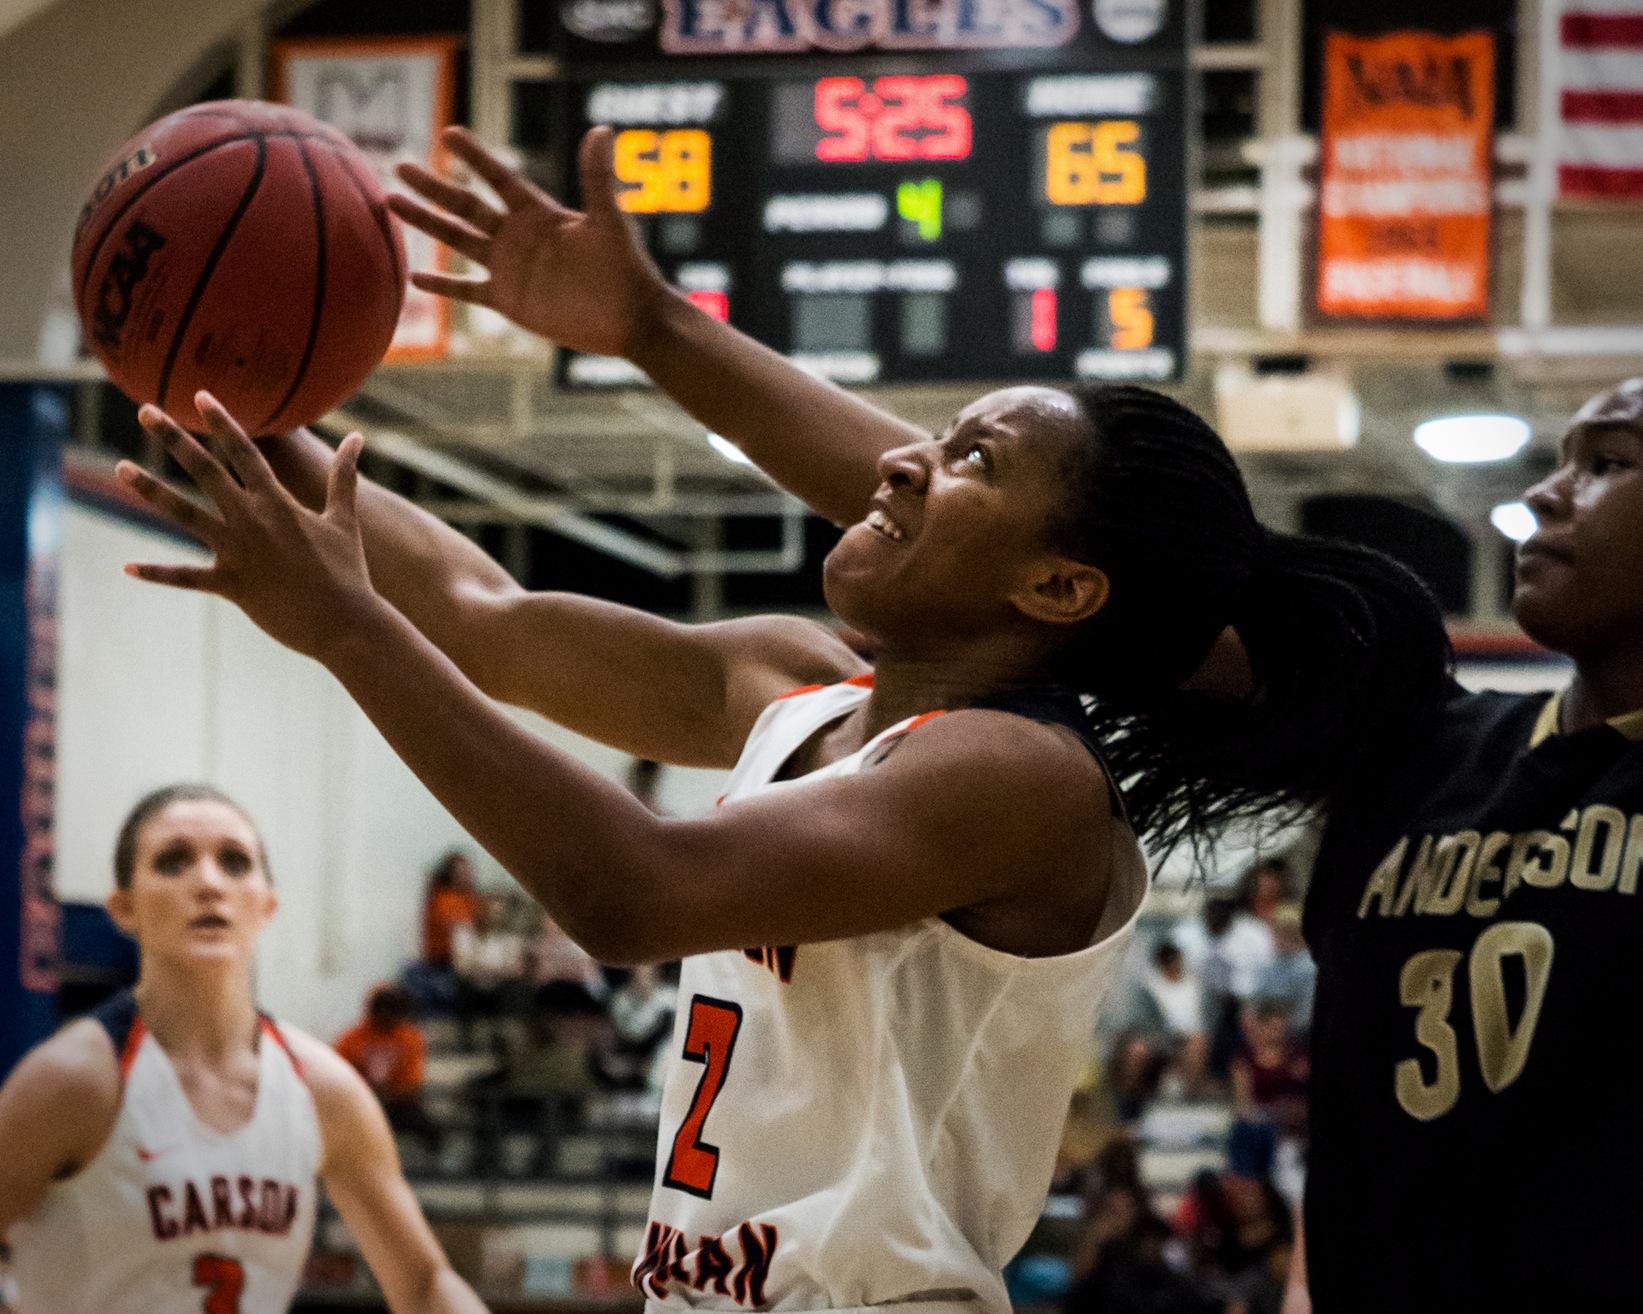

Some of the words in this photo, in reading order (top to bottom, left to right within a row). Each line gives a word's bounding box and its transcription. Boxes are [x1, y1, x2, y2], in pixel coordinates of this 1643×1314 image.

[670, 0, 1068, 48] EAGLES
[613, 129, 712, 213] 58
[1046, 121, 1147, 206] 65
[896, 179, 943, 242] 4
[1031, 287, 1058, 352] 1
[1108, 286, 1155, 350] 5
[1394, 921, 1555, 1121] 30
[661, 993, 743, 1201] 2
[147, 1174, 297, 1242] CARSON
